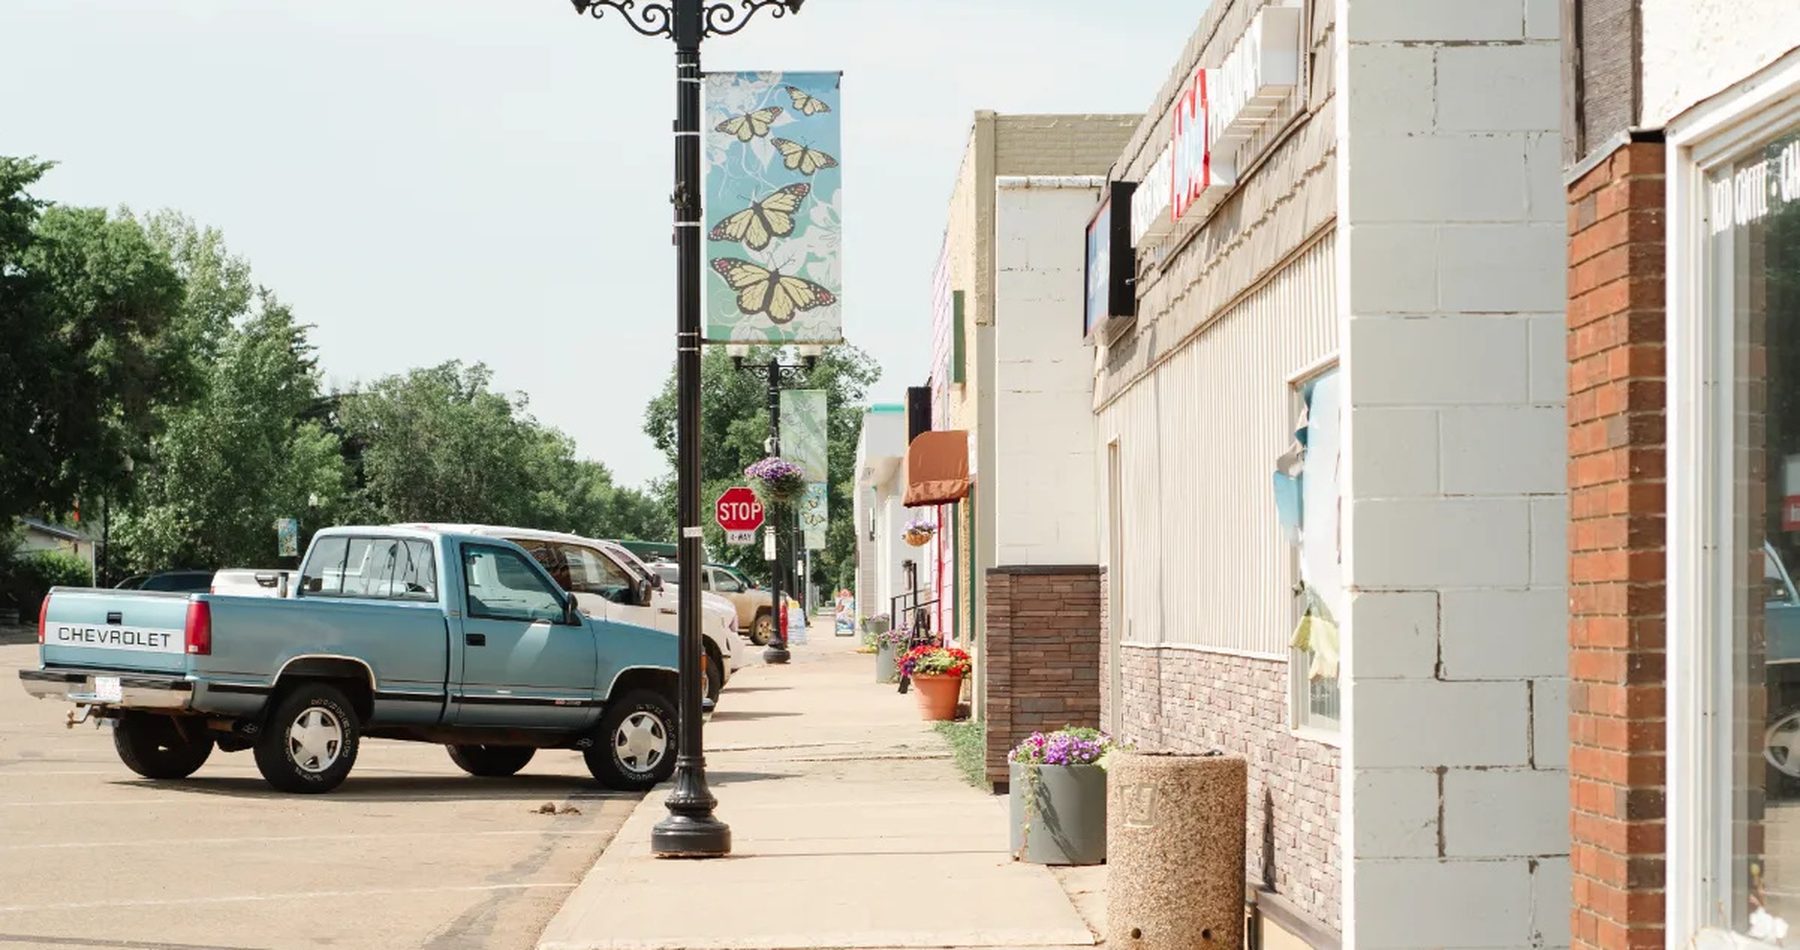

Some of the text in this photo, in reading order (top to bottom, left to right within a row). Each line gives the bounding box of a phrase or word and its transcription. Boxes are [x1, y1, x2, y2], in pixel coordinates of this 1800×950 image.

[719, 502, 762, 521] STOP
[730, 533, 752, 541] 4-WAY
[58, 627, 171, 648] CHEVROLET
